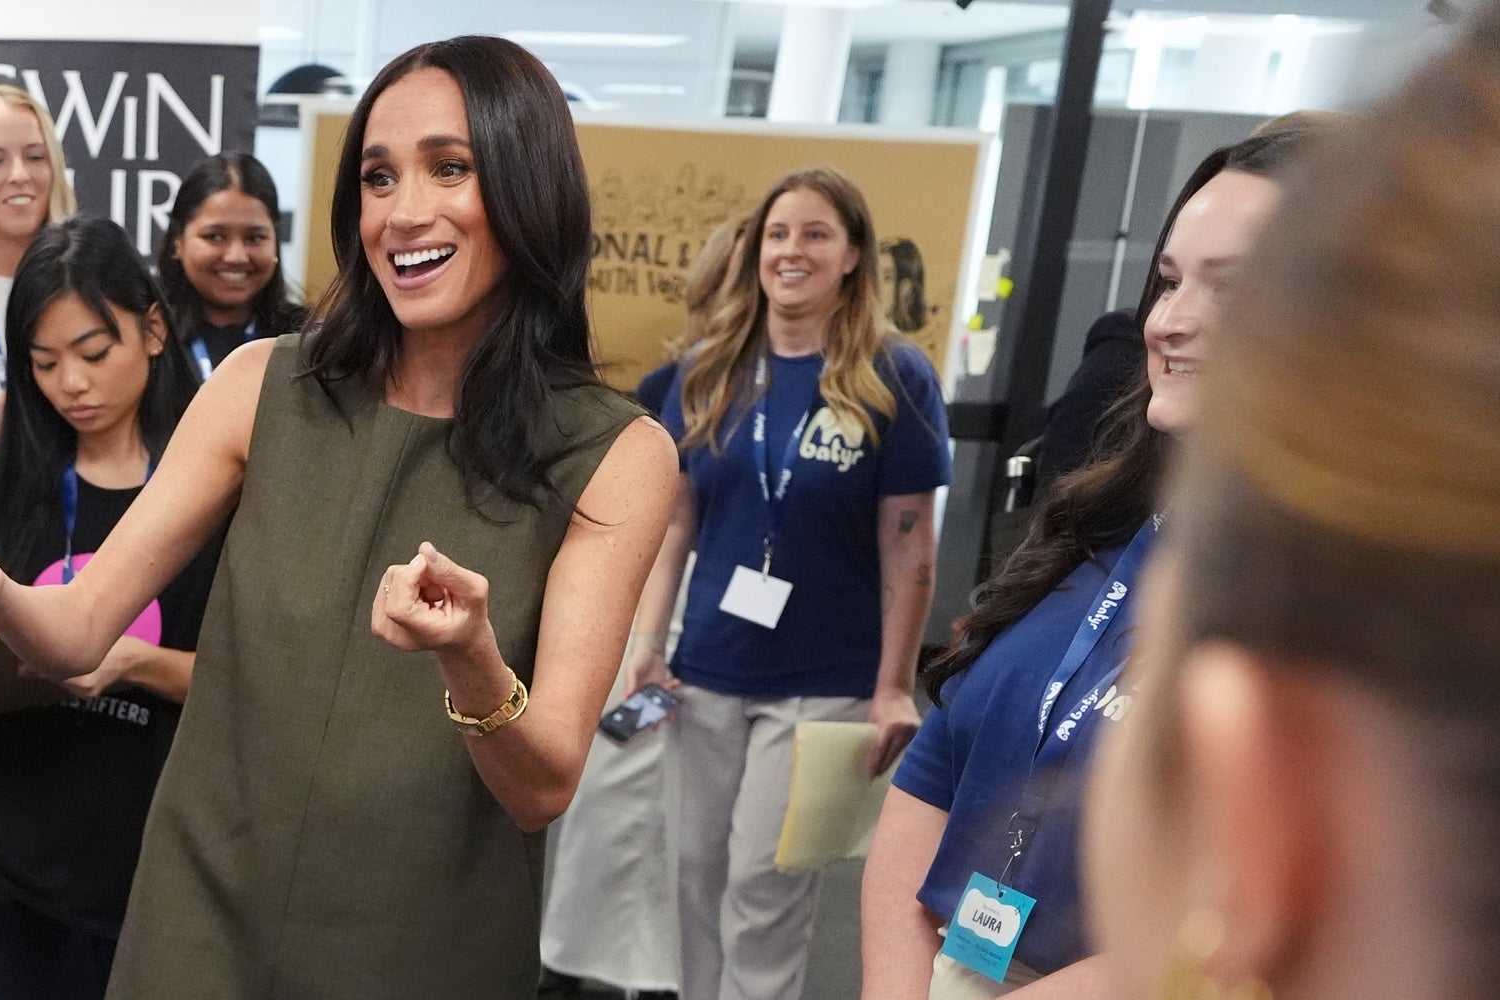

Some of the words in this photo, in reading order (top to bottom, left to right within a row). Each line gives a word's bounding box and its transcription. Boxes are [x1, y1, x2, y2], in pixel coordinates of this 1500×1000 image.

[799, 437, 865, 473] batyr
[1087, 599, 1118, 631] batyr
[1069, 688, 1100, 721] batyr
[972, 908, 1003, 934] LAURA
